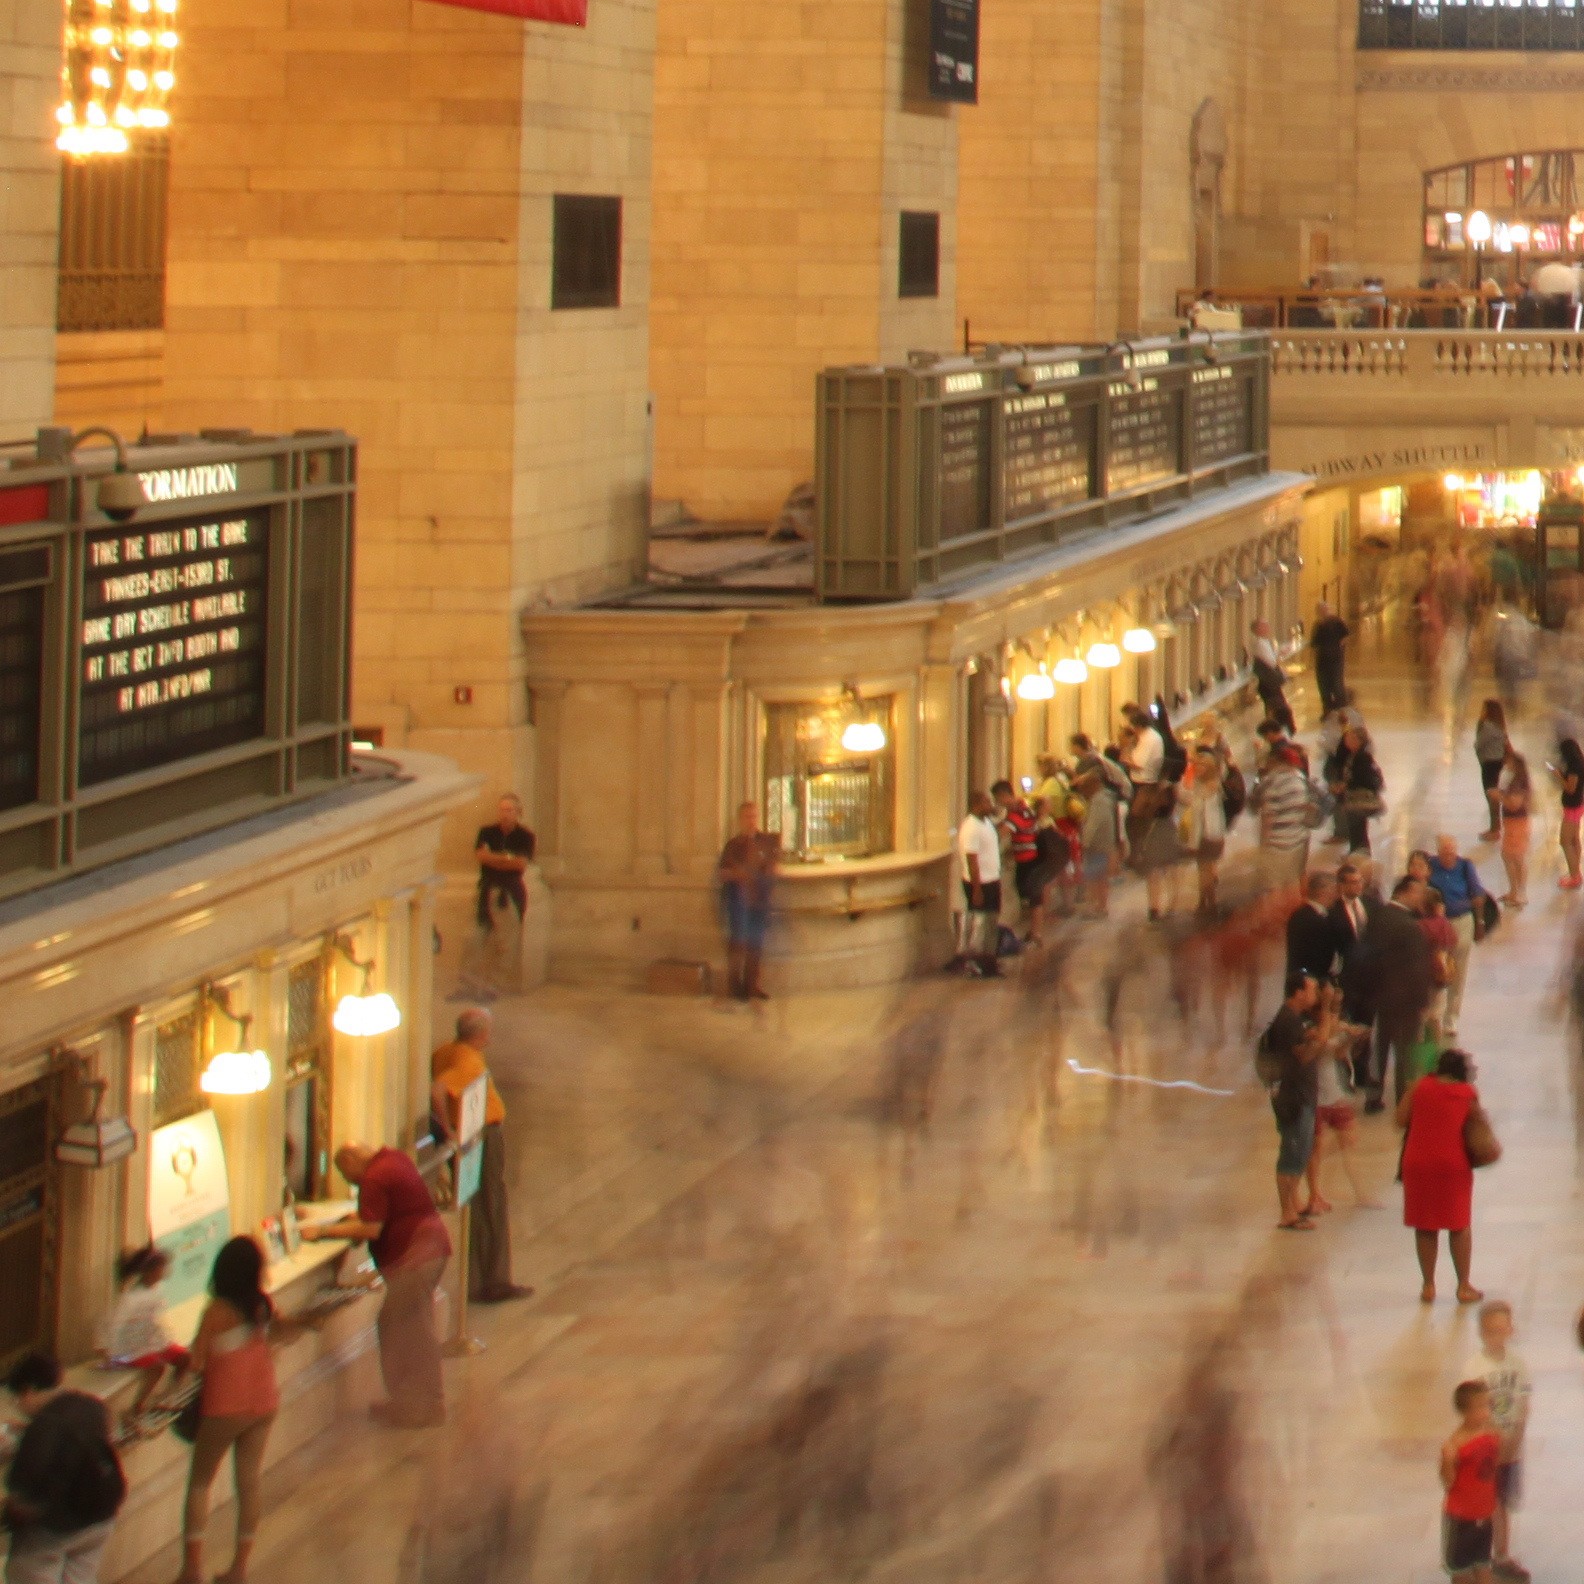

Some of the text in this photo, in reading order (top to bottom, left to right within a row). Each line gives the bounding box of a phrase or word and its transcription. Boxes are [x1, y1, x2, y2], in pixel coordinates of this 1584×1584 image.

[1301, 445, 1486, 476] SUBWAY SHUTTLE
[137, 462, 237, 502] ORMATION
[123, 535, 145, 562] THE
[147, 530, 181, 557] TRAIN
[183, 527, 198, 552] TO
[200, 523, 220, 549] THE
[113, 611, 137, 640] DAY
[137, 600, 190, 634] SCHEDULE
[192, 589, 246, 622] AVAILABLE
[85, 655, 104, 683] AT
[106, 650, 129, 677] THE
[155, 639, 184, 666] INFO
[185, 631, 218, 660] BOOTH
[117, 686, 135, 713] AT
[337, 858, 373, 885] TOURS
